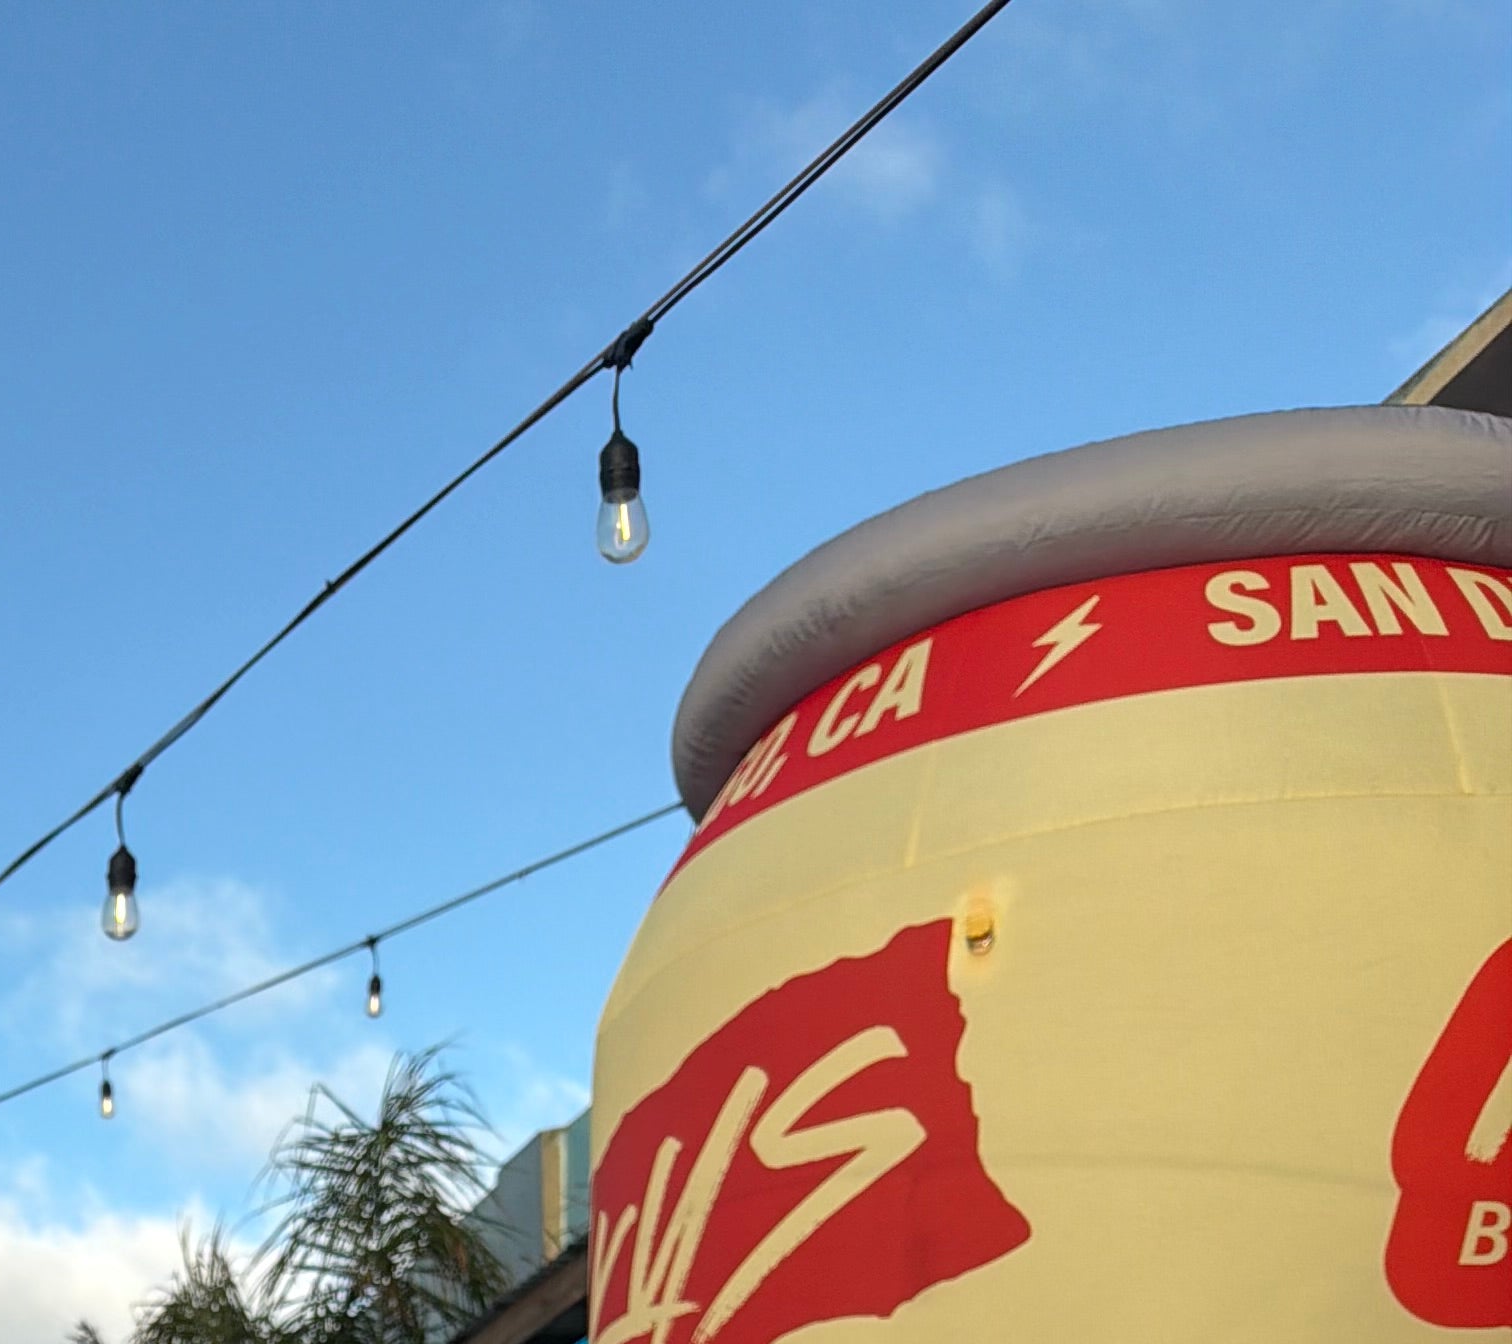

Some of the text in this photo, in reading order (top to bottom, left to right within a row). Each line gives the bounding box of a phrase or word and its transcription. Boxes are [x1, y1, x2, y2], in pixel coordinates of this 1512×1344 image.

[1204, 562, 1512, 647] SAN D
[807, 637, 934, 758] CA
